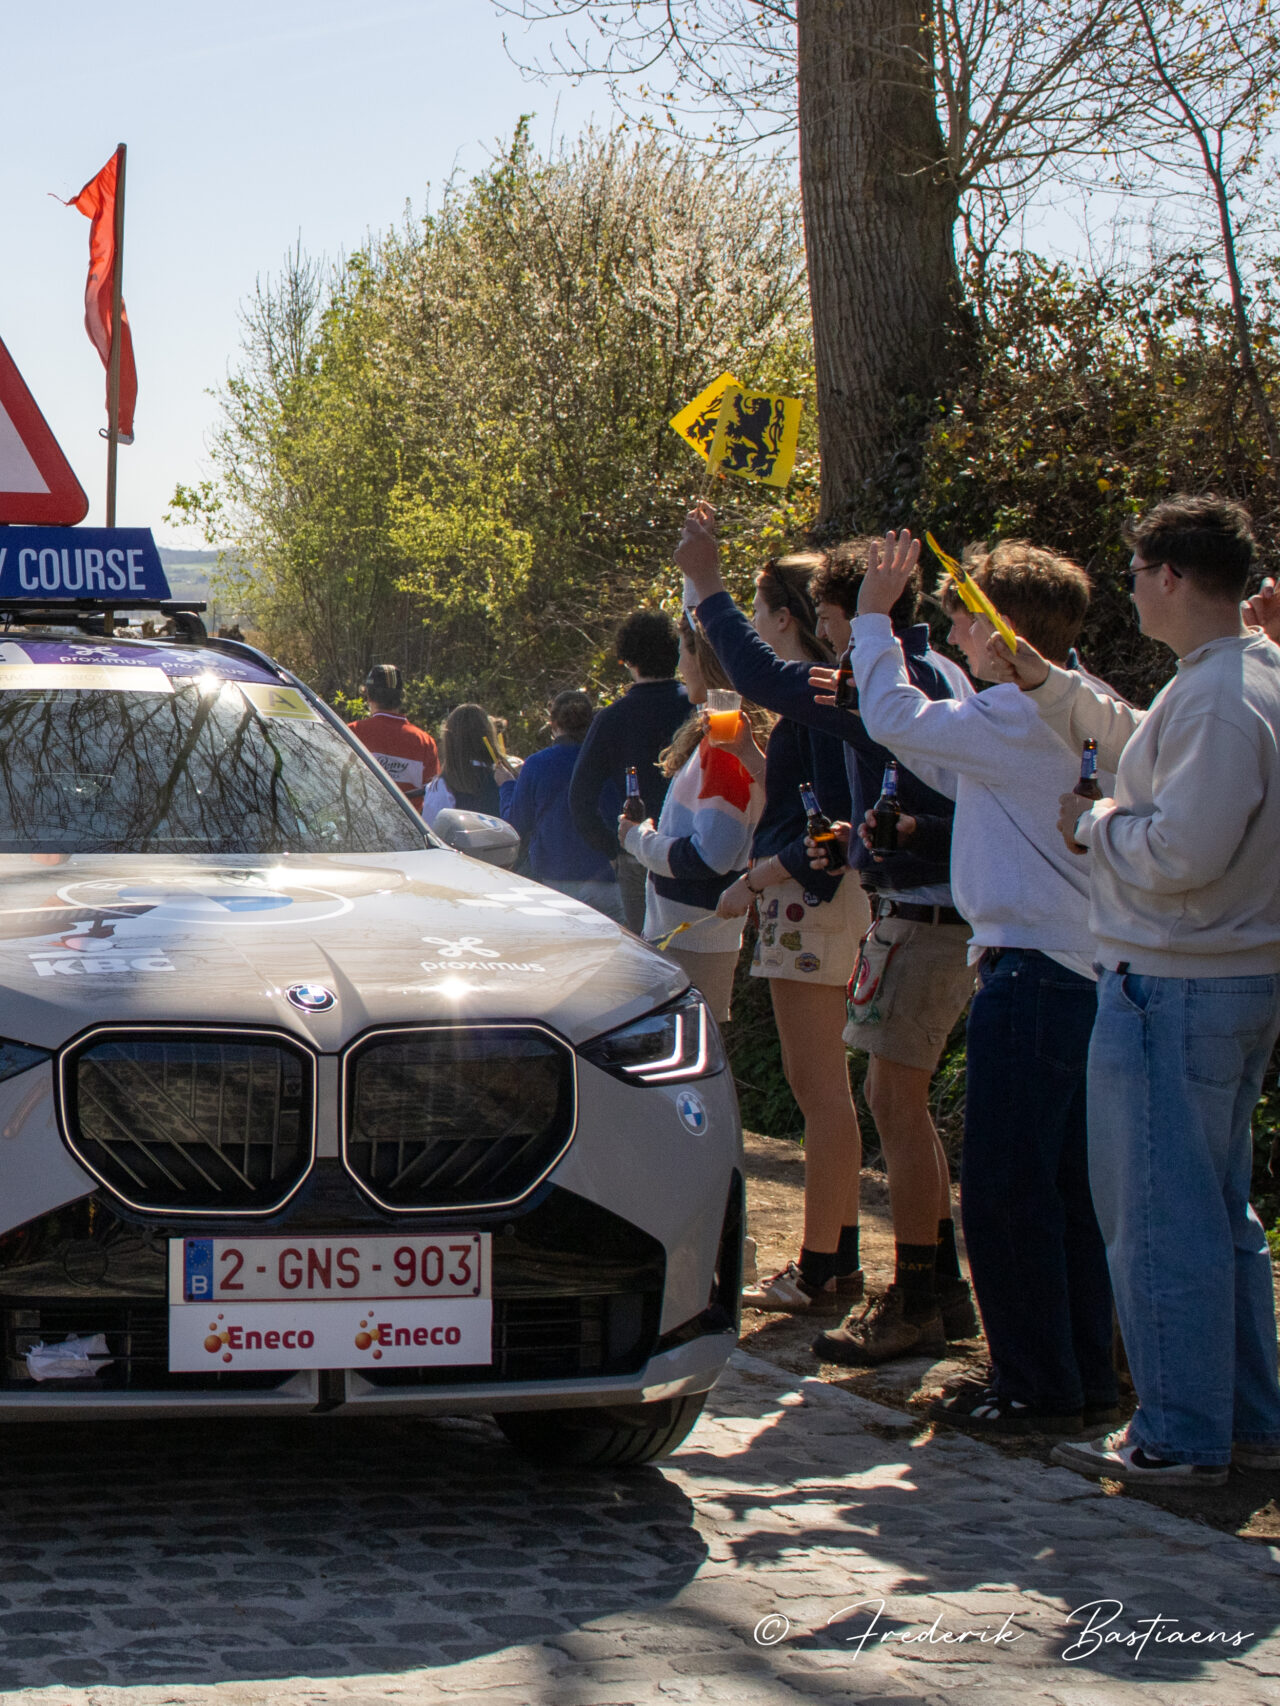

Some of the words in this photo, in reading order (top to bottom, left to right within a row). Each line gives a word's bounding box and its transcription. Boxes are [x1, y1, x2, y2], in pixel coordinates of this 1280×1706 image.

[18, 548, 147, 591] COURSE
[59, 655, 148, 666] proximus
[32, 957, 177, 977] KBC
[420, 961, 546, 972] proximus
[191, 1275, 208, 1294] B
[227, 1326, 315, 1350] Eneco
[377, 1323, 461, 1347] Eneco
